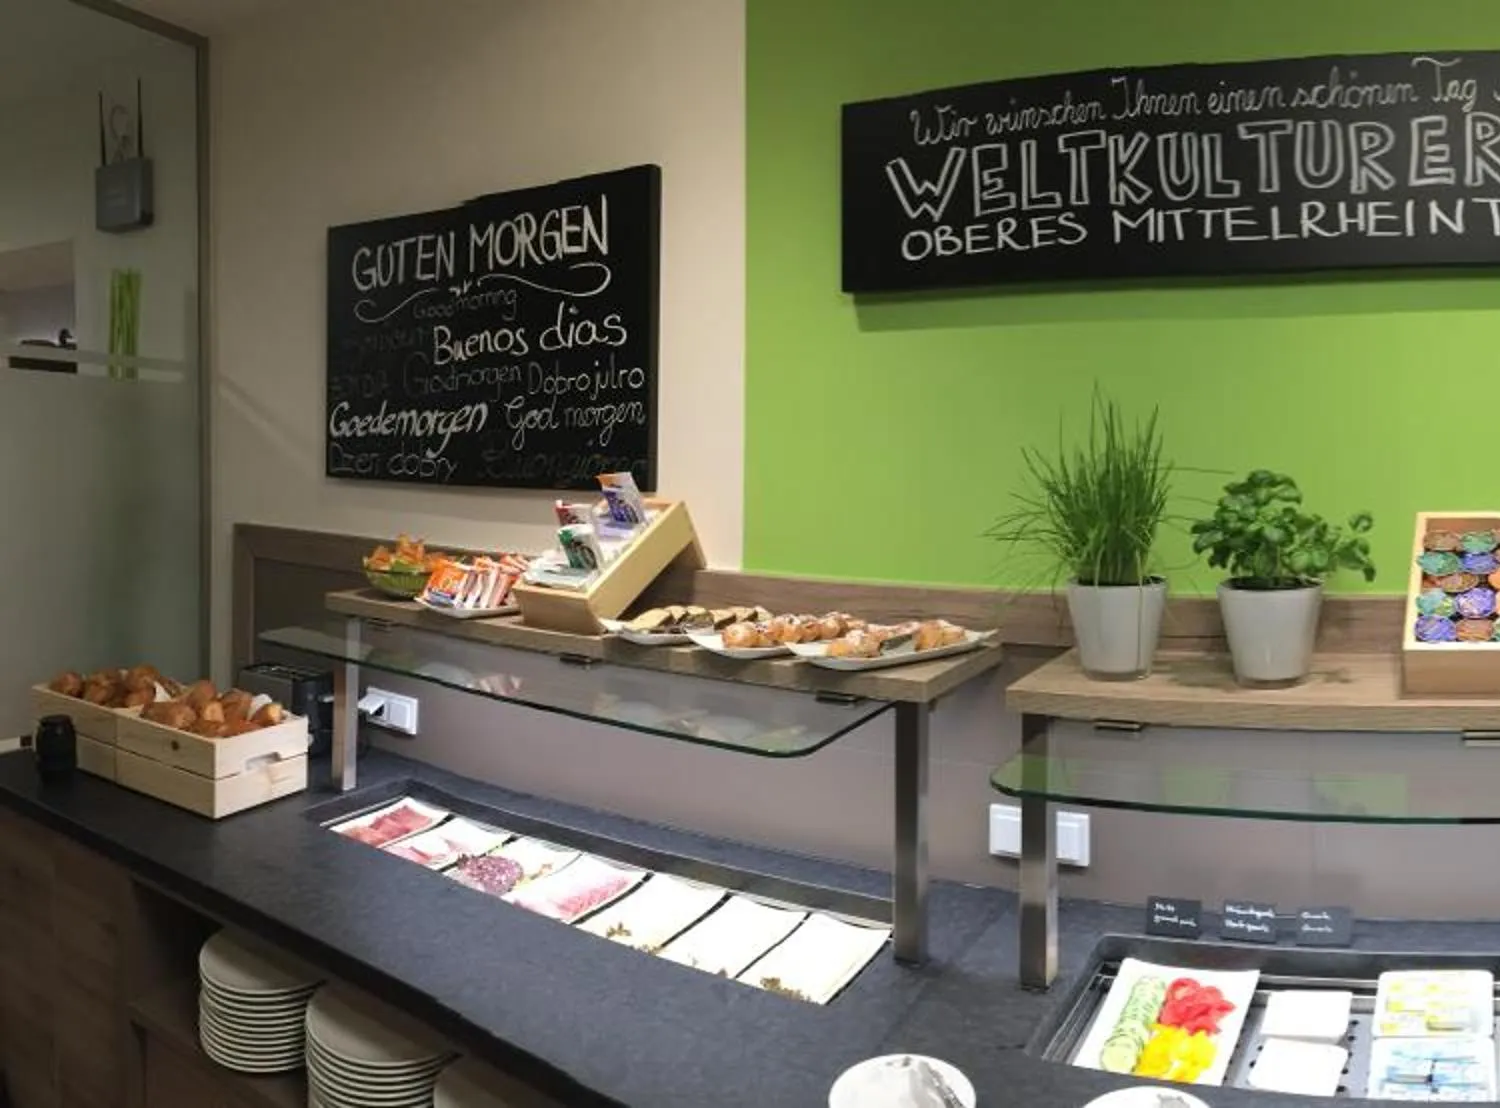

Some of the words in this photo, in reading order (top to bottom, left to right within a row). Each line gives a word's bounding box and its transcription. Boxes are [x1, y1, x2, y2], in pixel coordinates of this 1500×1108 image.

[911, 104, 978, 146] Wir
[1111, 76, 1201, 120] Ihnen
[1208, 81, 1286, 115] einen
[1411, 57, 1477, 112] Tag
[351, 231, 455, 292] GUTEN
[469, 193, 609, 272] MORGEN
[902, 212, 1088, 261] OBERES
[433, 325, 529, 365] Buenos
[539, 301, 628, 351] dias
[329, 400, 488, 459] Goedemorgen
[565, 401, 646, 447] morgen
